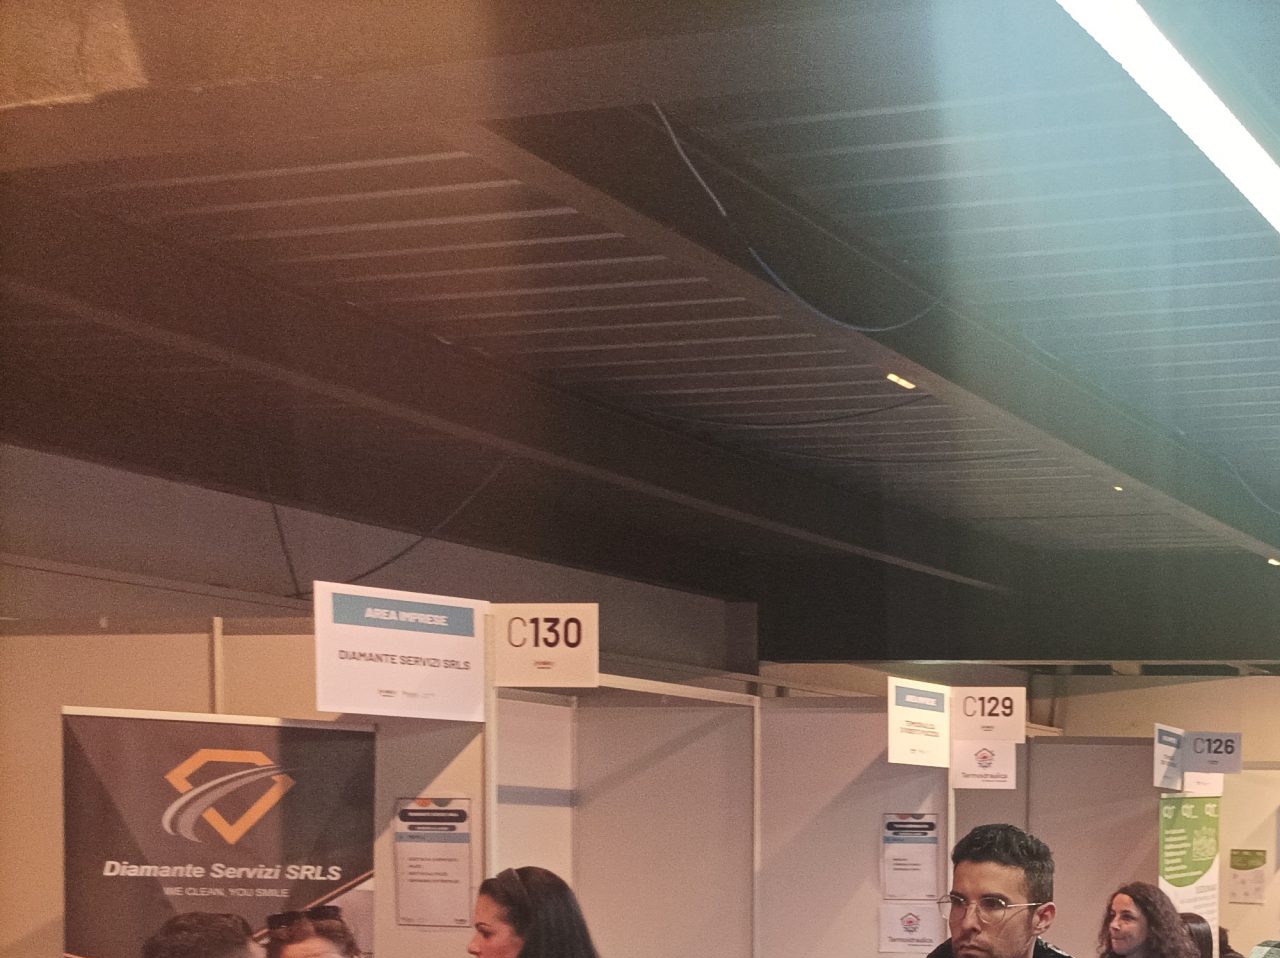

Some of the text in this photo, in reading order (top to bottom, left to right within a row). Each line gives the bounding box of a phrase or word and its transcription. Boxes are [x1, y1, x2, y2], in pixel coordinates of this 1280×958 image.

[364, 607, 449, 626] AREA IMPRESE
[507, 616, 582, 648] C130
[338, 650, 471, 671] DIAMANTE SERVIZI SRLS
[963, 696, 1014, 717] C129
[1193, 737, 1236, 755] C126
[103, 860, 342, 881] Diamante Servizi SRLS
[164, 887, 184, 896] WE
[228, 888, 254, 897] YOU
[255, 888, 290, 898] SMILE
